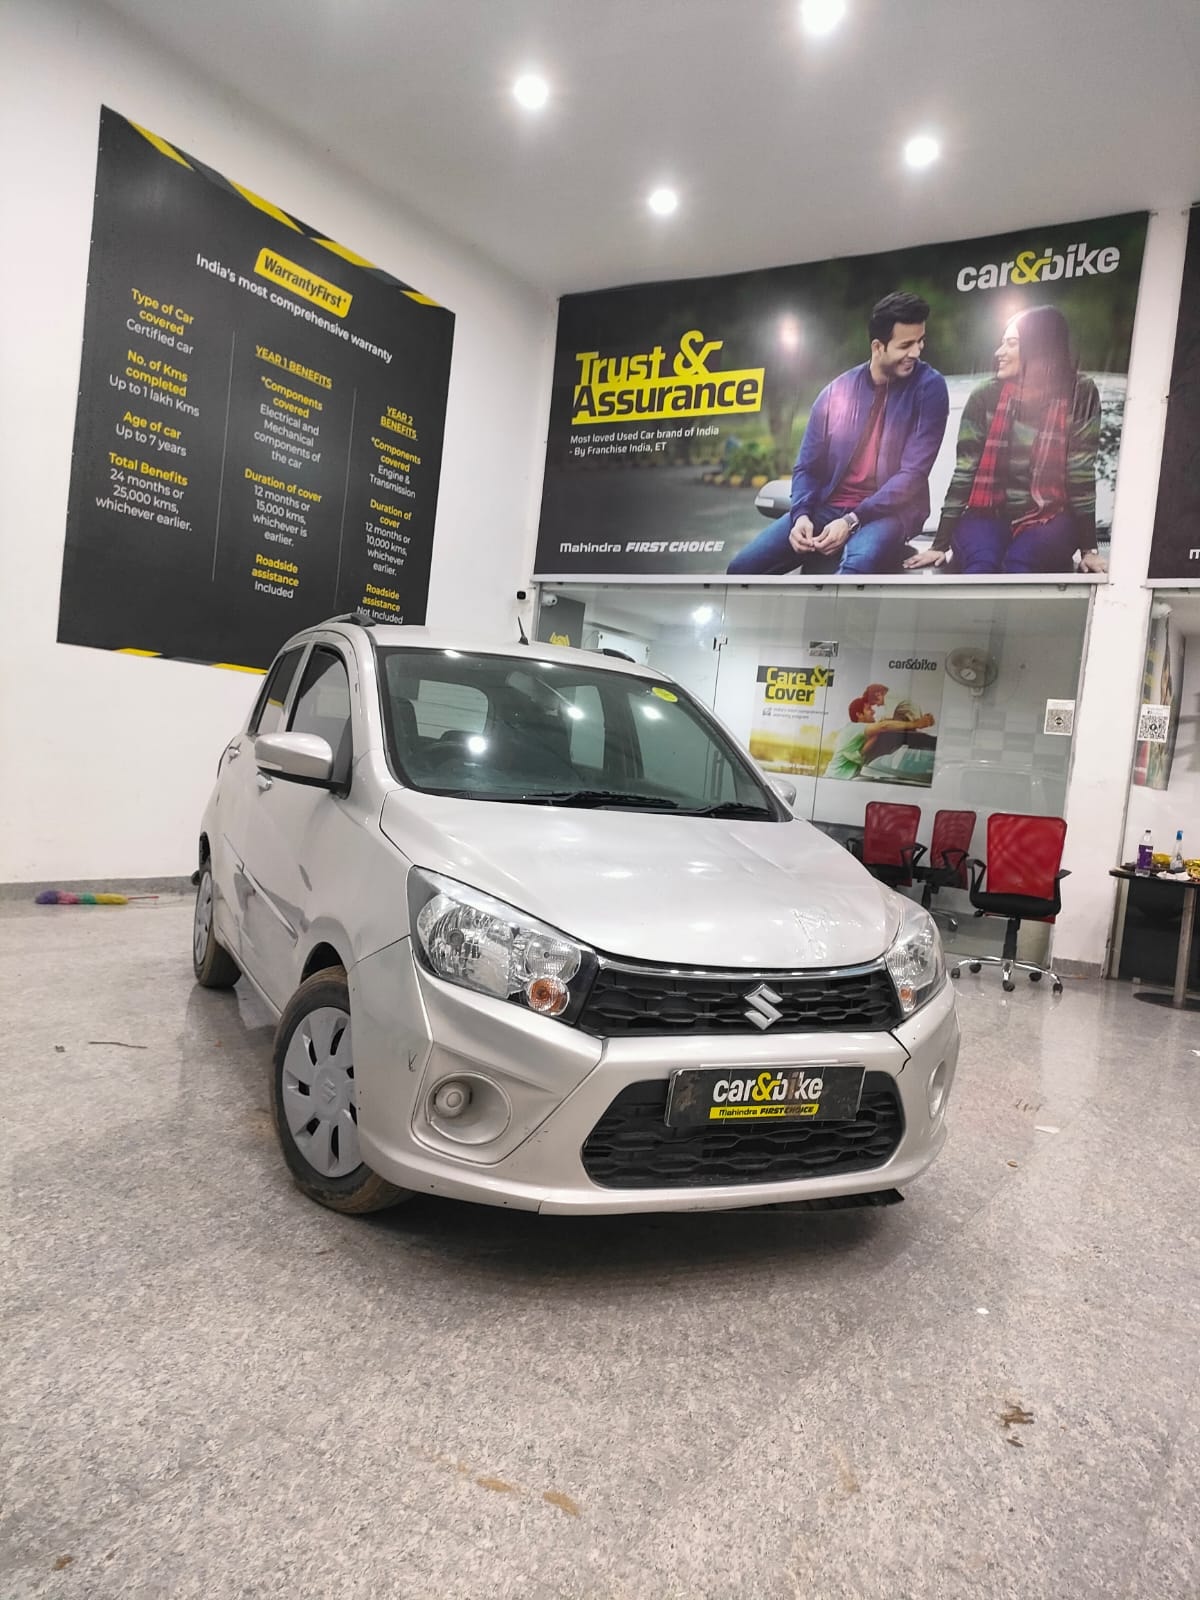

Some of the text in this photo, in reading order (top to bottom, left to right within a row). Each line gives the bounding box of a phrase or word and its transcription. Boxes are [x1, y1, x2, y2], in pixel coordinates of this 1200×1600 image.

[956, 242, 1120, 292] car&bike
[132, 288, 194, 324] Type of Car
[196, 253, 392, 364] India's most comprehensive warranty
[139, 310, 184, 336] covered
[127, 318, 193, 354] Certified car
[128, 350, 188, 382] No. of Kms
[256, 345, 281, 365] YEAR
[289, 361, 332, 389] BENEFITS
[576, 330, 723, 385] Trust &
[126, 367, 186, 397] completed
[109, 374, 199, 416] Up to 1 lakh Kms
[273, 397, 309, 418] covered
[574, 378, 759, 418] Assurance
[123, 411, 181, 439] Age of car
[260, 403, 319, 435] Electrical and
[380, 416, 416, 439] BENEFITS
[387, 405, 413, 425] YEAR 2
[116, 423, 186, 456] Up to 7 years
[264, 420, 314, 447] Mechanical
[570, 426, 719, 444] Most loved Used Car brand of India
[254, 431, 321, 463] components of
[574, 448, 585, 457] By
[587, 444, 627, 456] Franchise
[629, 443, 653, 452] India,
[655, 442, 667, 451] ET
[109, 452, 188, 486] Total Benefits
[272, 451, 302, 469] the car
[381, 455, 410, 472] covered
[110, 468, 184, 499] 24 months or
[245, 468, 322, 502] Duration of cover
[369, 473, 415, 499] Transmission
[378, 464, 410, 485] Engine &
[113, 485, 179, 514] 25,000 kms,
[254, 485, 310, 512] 12 months or
[370, 499, 412, 520] Duration of
[96, 497, 192, 531] whichever earlier.
[256, 499, 306, 525] 15,000 kms,
[380, 516, 400, 528] cover
[253, 513, 307, 537] whichever is
[365, 522, 410, 544] 12 months or
[264, 531, 294, 547] earlier.
[366, 535, 389, 550] 10,000
[625, 542, 667, 552] FIRST
[669, 541, 725, 552] CHOICE
[256, 553, 298, 574] Roadside
[367, 549, 404, 566] whichever
[252, 567, 299, 587] assistance
[255, 581, 293, 598] Included
[362, 596, 400, 612] assistance
[366, 584, 399, 600] Roadside
[357, 606, 403, 624] Not Included
[767, 665, 834, 686] Care &
[889, 659, 937, 670] car&bike
[765, 684, 814, 702] Cover
[713, 1071, 823, 1102] car&bike
